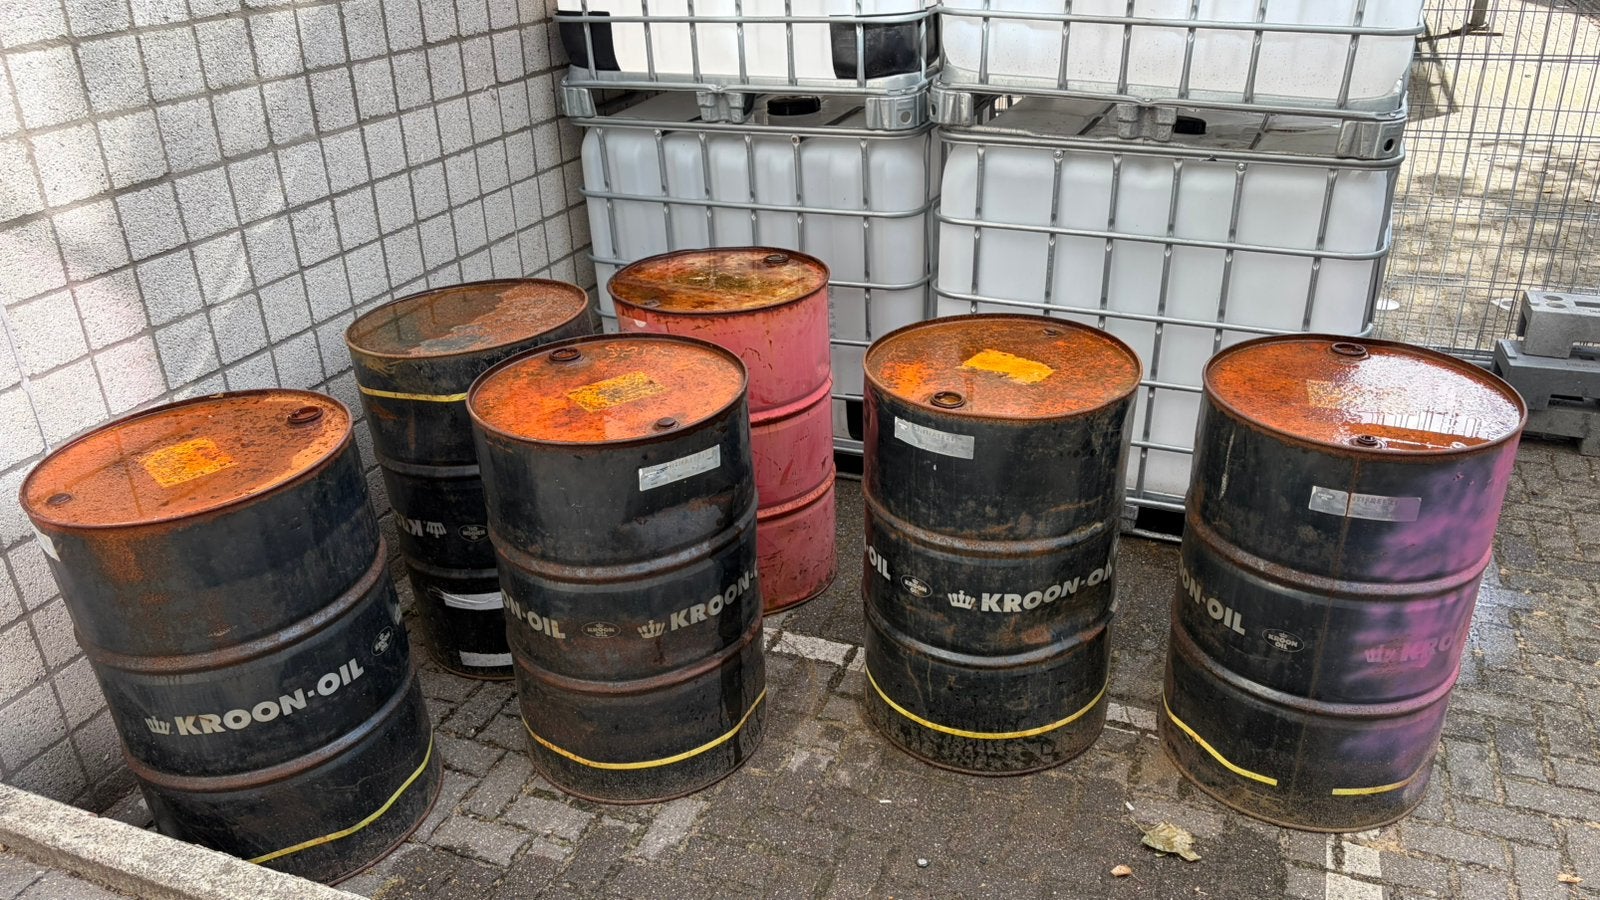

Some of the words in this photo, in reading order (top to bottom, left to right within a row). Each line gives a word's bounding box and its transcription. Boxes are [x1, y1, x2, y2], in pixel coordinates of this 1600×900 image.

[1267, 633, 1298, 648] KROON
[1274, 641, 1289, 650] OIL
[174, 657, 365, 736] KROON-OIL
